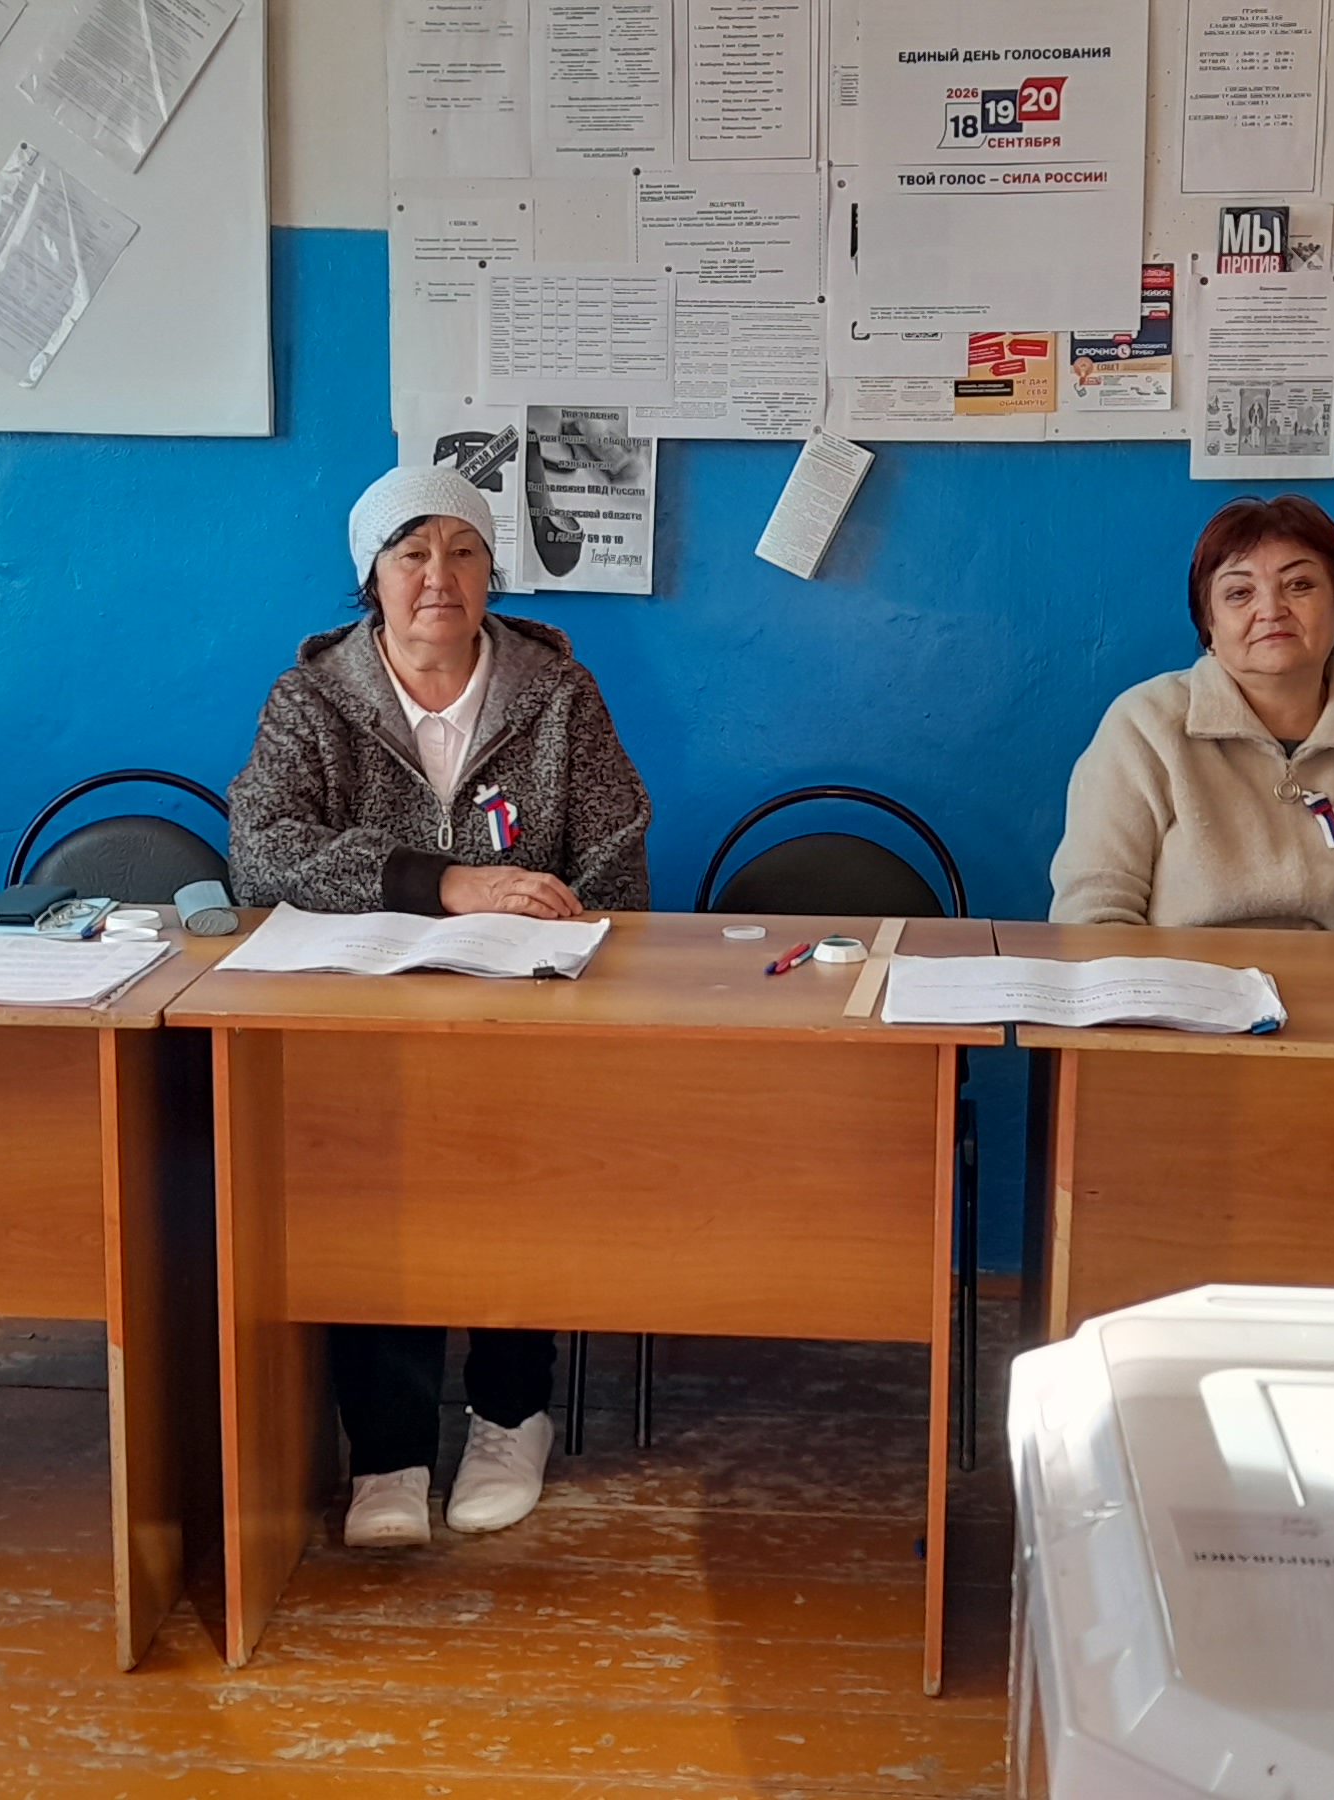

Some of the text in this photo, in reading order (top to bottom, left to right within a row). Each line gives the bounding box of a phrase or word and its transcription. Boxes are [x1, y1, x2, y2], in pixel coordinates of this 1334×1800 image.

[898, 47, 1111, 64] ЕДИНЫЙ ДЕНЬ ГОЛОСОВАНИЯ
[946, 87, 979, 99] 2026
[950, 87, 1058, 138] 18 19 20
[988, 136, 1061, 149] СЕНТЯБРЯ
[898, 171, 935, 186] ТВОЙ
[939, 174, 986, 185] ГОЛОС
[1002, 172, 1041, 184] СИЛА
[1045, 171, 1108, 184] РОССИИ!
[1221, 213, 1281, 254] МЫ
[1221, 255, 1281, 274] ПРОТИВ
[1075, 347, 1118, 356] СРОЧНО
[460, 428, 516, 478] ОРЯЧАЯ ЛИНИЯ
[588, 485, 609, 495] МВД
[602, 511, 643, 520] области
